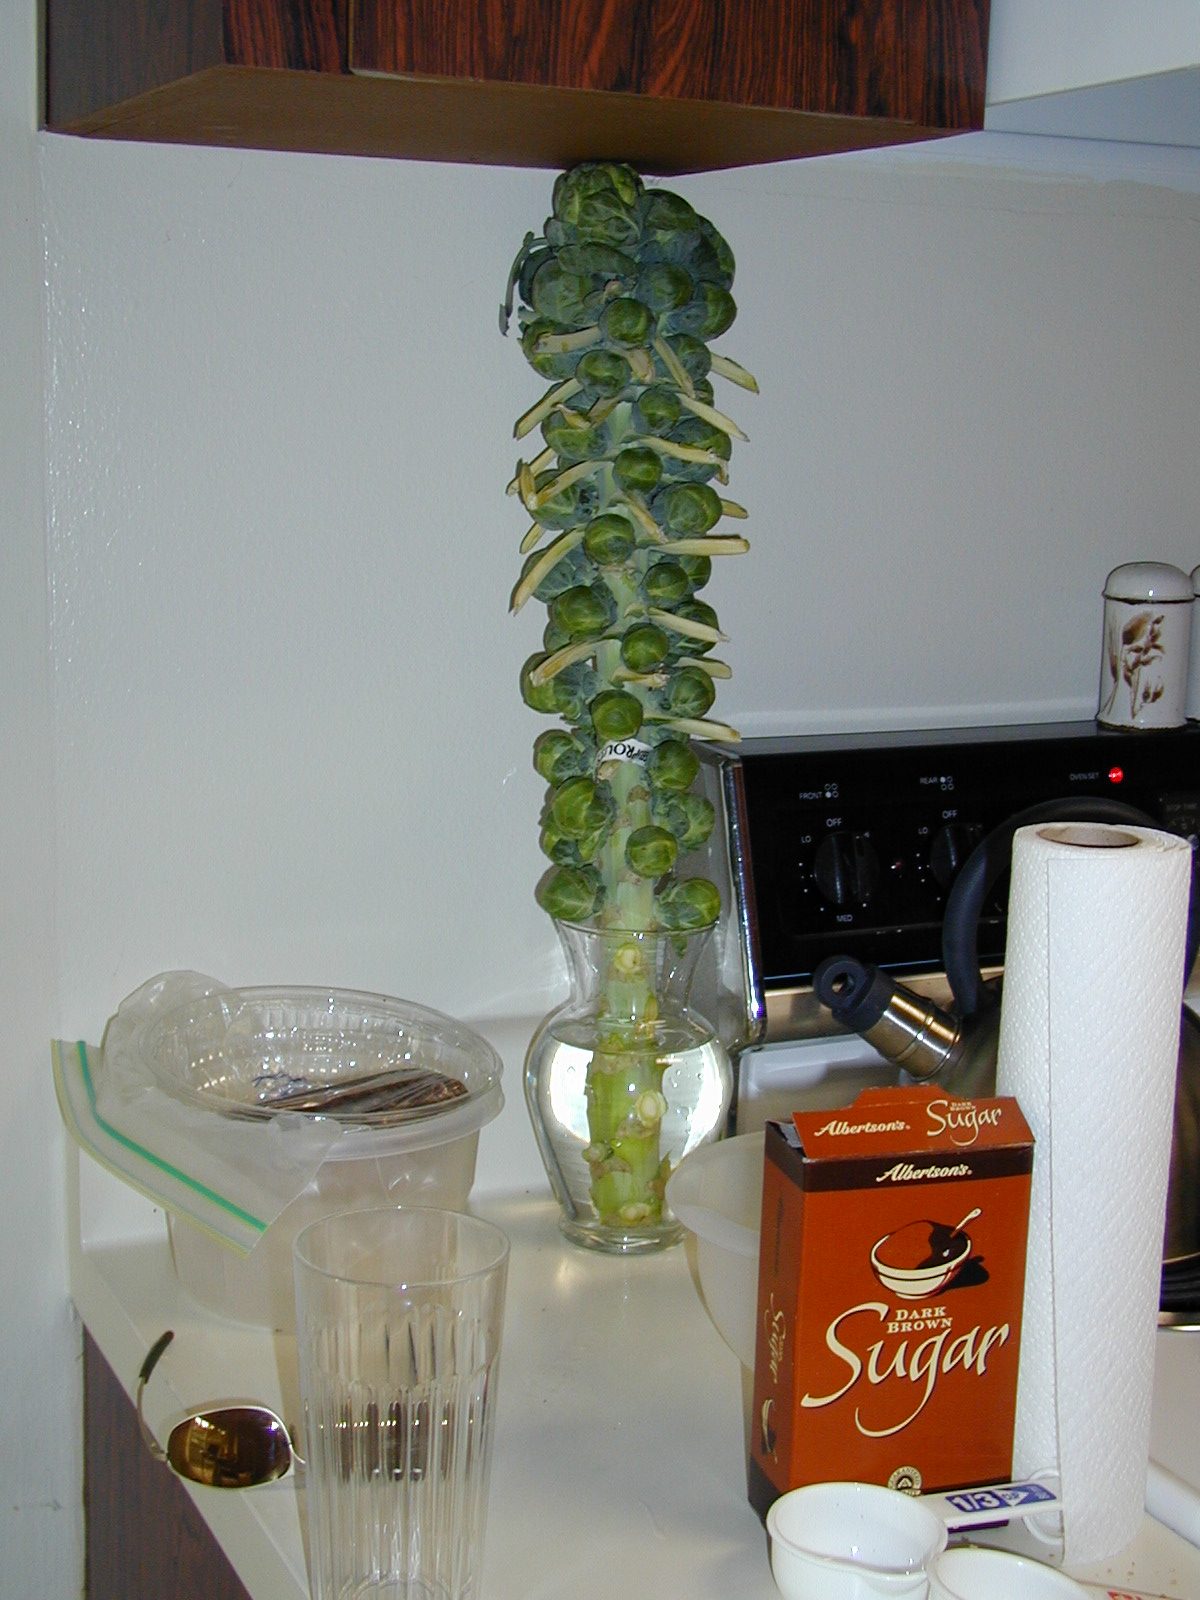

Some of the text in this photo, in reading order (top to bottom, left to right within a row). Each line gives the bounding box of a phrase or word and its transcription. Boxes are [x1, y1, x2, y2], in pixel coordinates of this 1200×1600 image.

[799, 792, 822, 800] FRONT
[942, 809, 958, 819] OFF
[826, 818, 842, 827] OFF
[918, 826, 929, 835] LO
[801, 835, 812, 844] LO
[836, 914, 853, 922] MED
[814, 1099, 1002, 1147] Albertson's Sugar
[876, 1163, 969, 1183] Albertson's
[895, 1306, 947, 1321] DARK
[887, 1317, 953, 1334] BROWN
[800, 1302, 1010, 1438] Sugar
[952, 1491, 1001, 1511] 1/3
